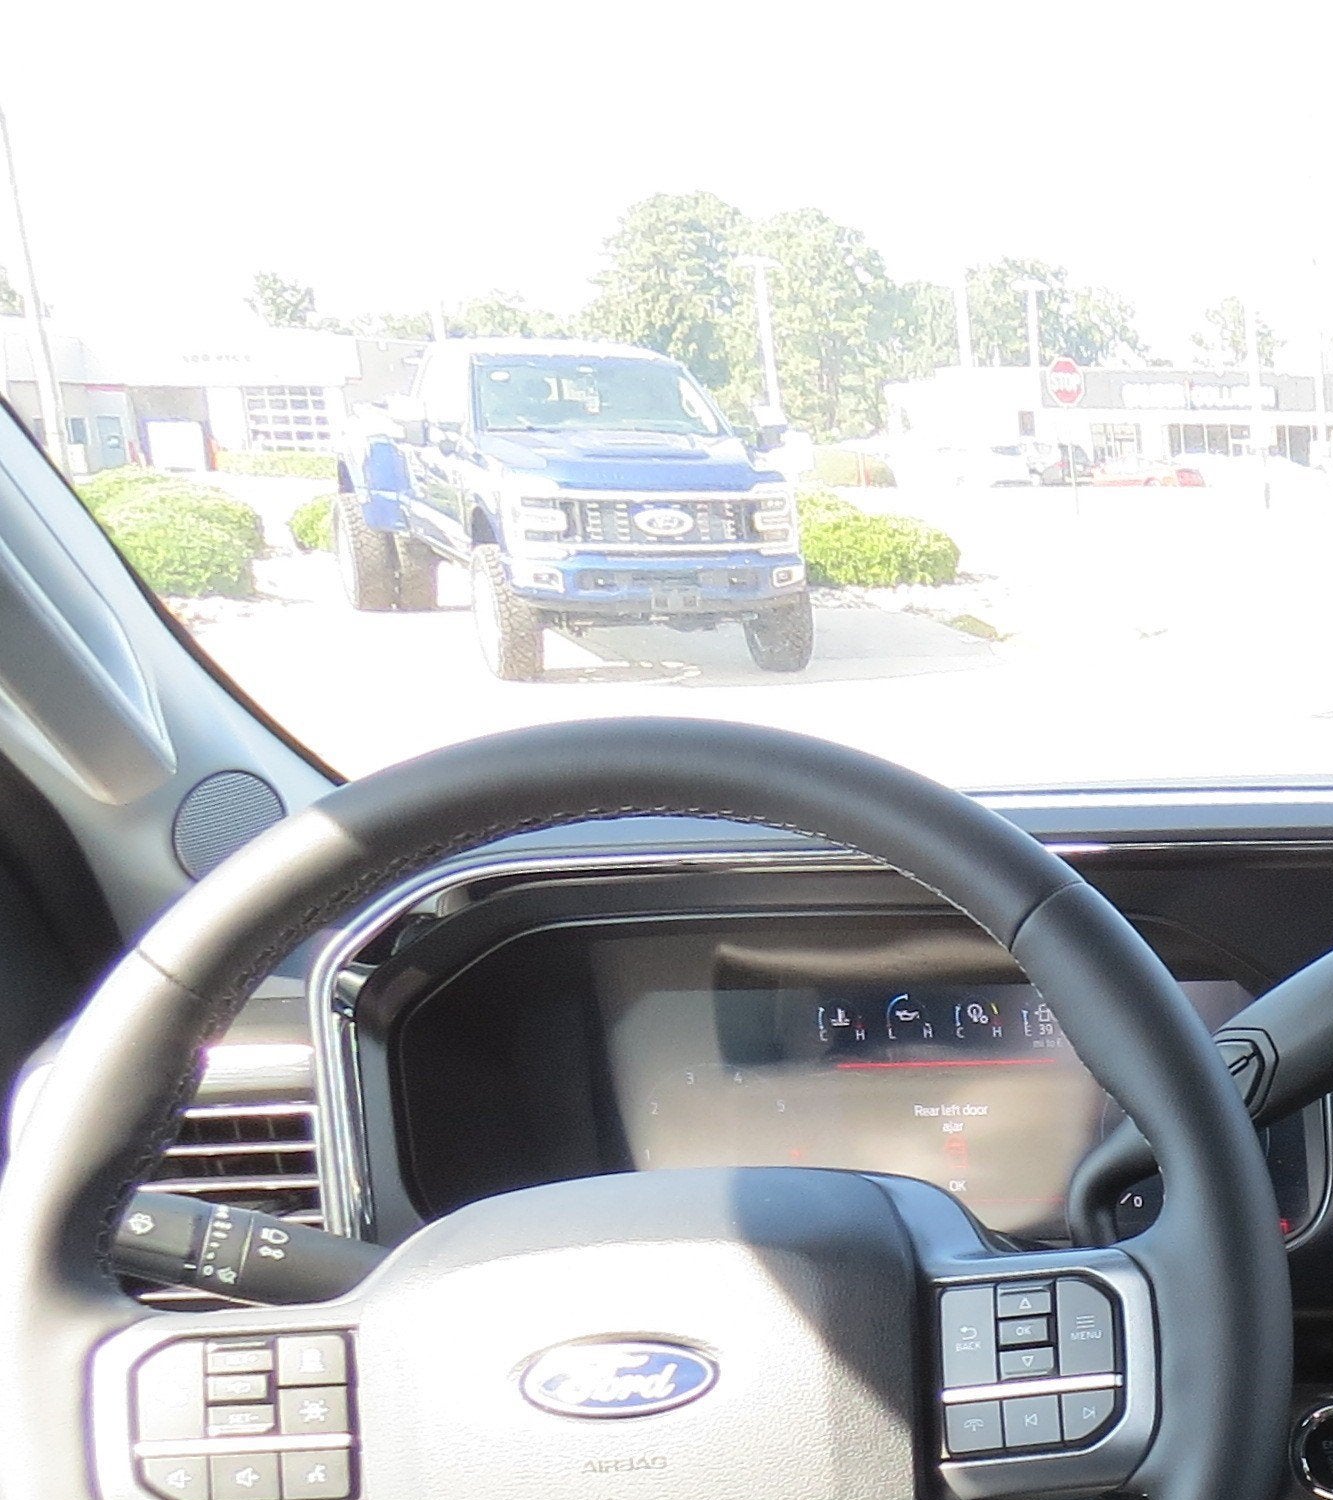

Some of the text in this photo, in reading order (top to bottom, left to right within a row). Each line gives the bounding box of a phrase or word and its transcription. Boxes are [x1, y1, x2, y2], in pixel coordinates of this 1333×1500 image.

[1039, 1023, 1054, 1036] 39
[913, 1103, 990, 1118] Rear left door
[948, 1179, 967, 1192] OK
[1015, 1325, 1033, 1338] OK
[1069, 1327, 1103, 1342] MENU
[954, 1338, 983, 1353] BACK
[581, 1454, 669, 1474] AIRBAG
